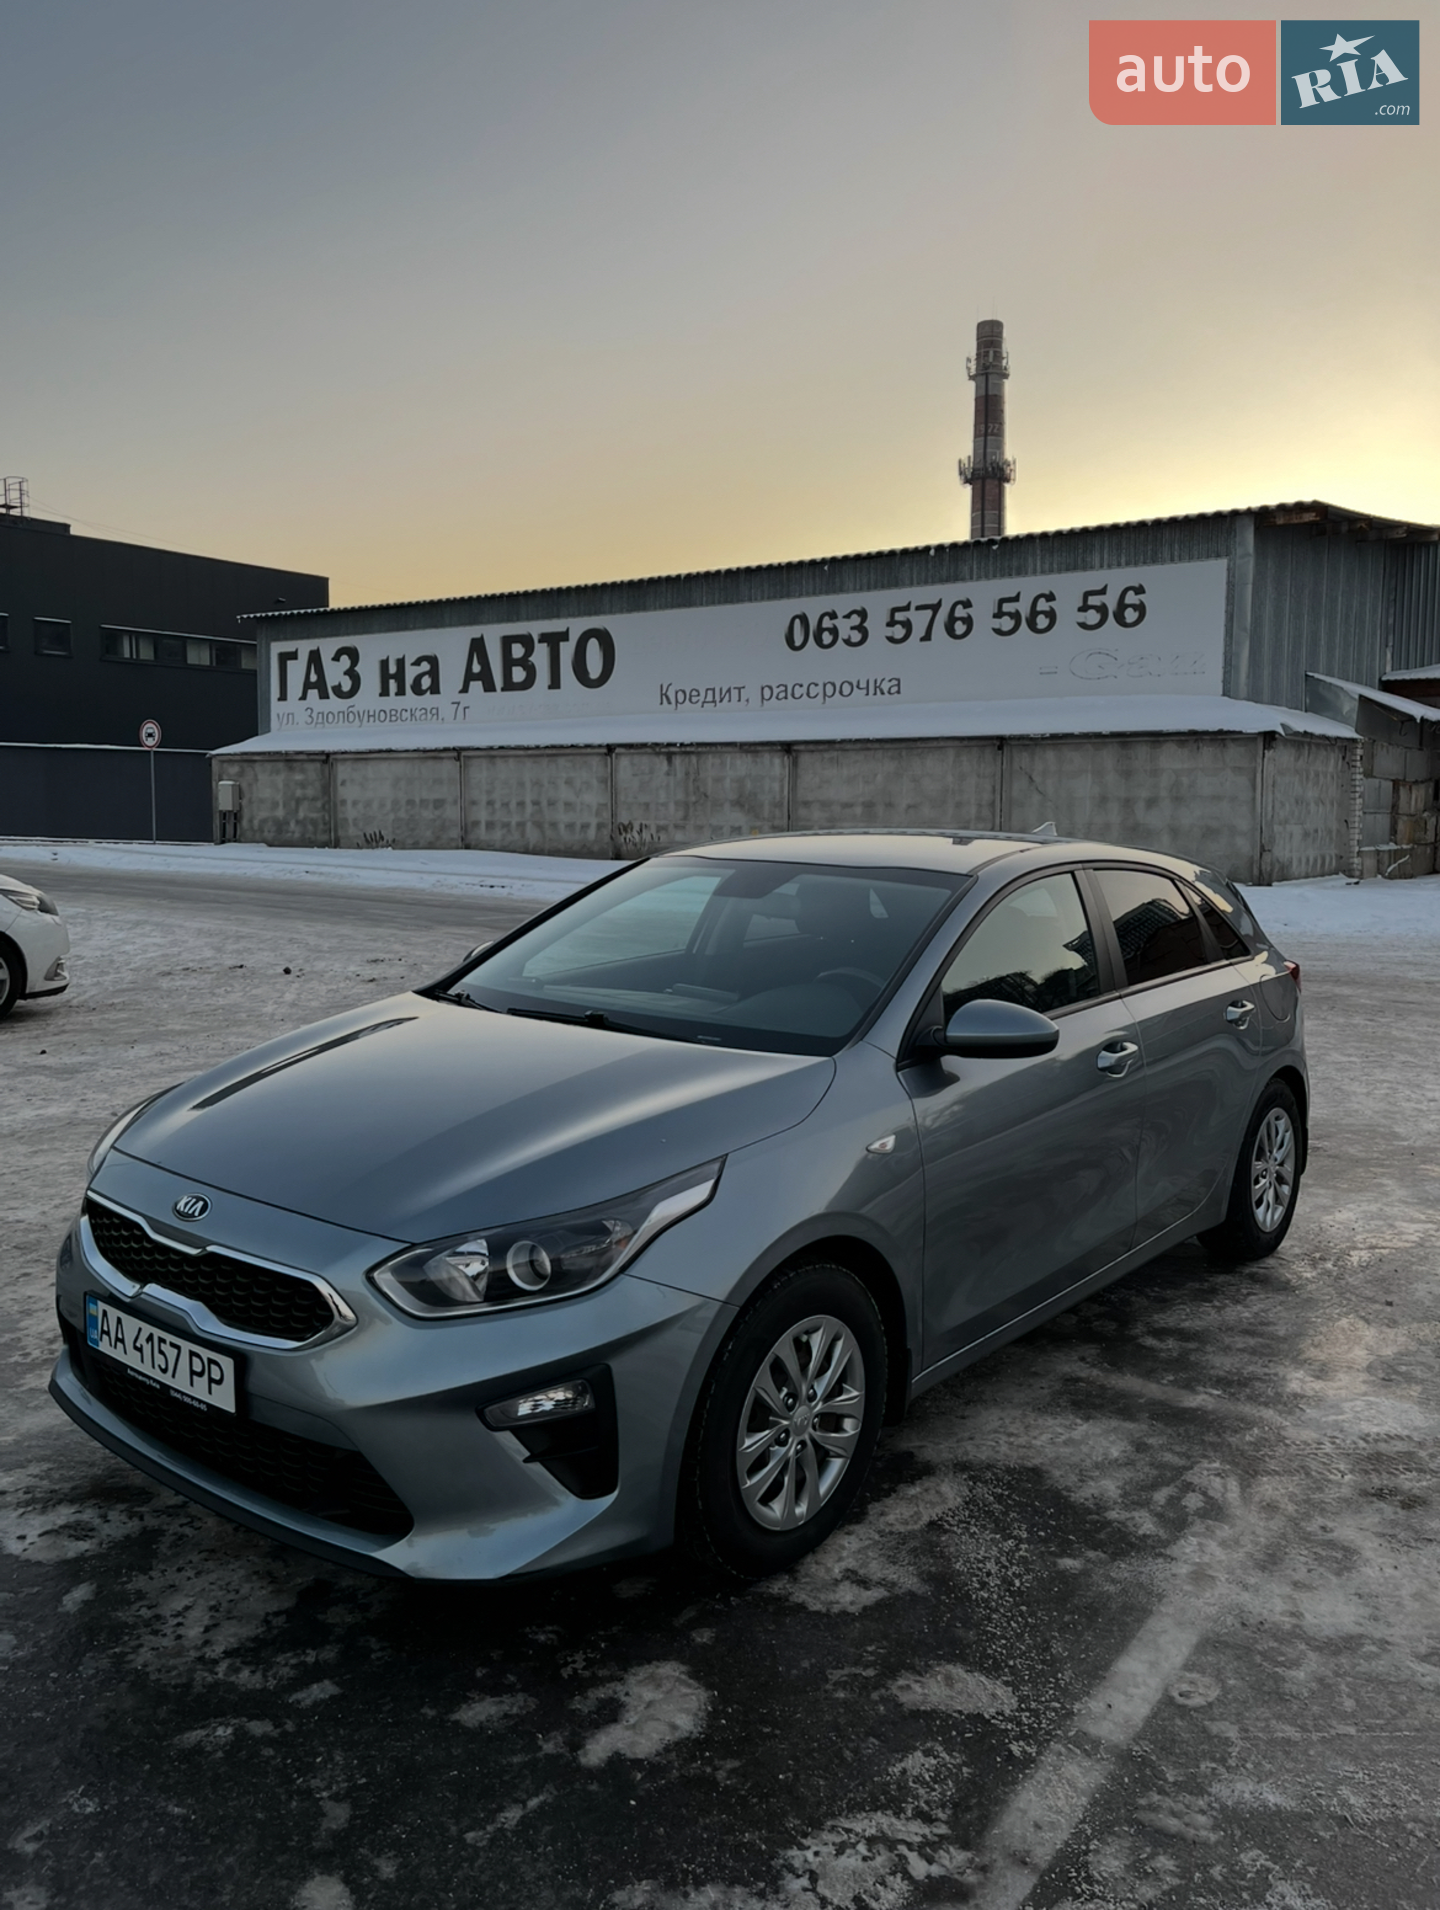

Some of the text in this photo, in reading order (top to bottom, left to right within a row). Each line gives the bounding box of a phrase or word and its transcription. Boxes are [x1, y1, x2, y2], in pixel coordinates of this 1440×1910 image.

[784, 582, 1147, 652] 063 576 56 56
[277, 625, 616, 702] ГАЗ на АВТО
[276, 709, 299, 731] ул.
[304, 703, 446, 729] Здолбуновская,
[451, 701, 471, 722] 7г
[659, 676, 902, 710] Кредит, рассрочка
[176, 1195, 204, 1217] KIA
[100, 1309, 127, 1356] AA
[133, 1327, 182, 1380] 4157
[189, 1349, 225, 1396] PP
